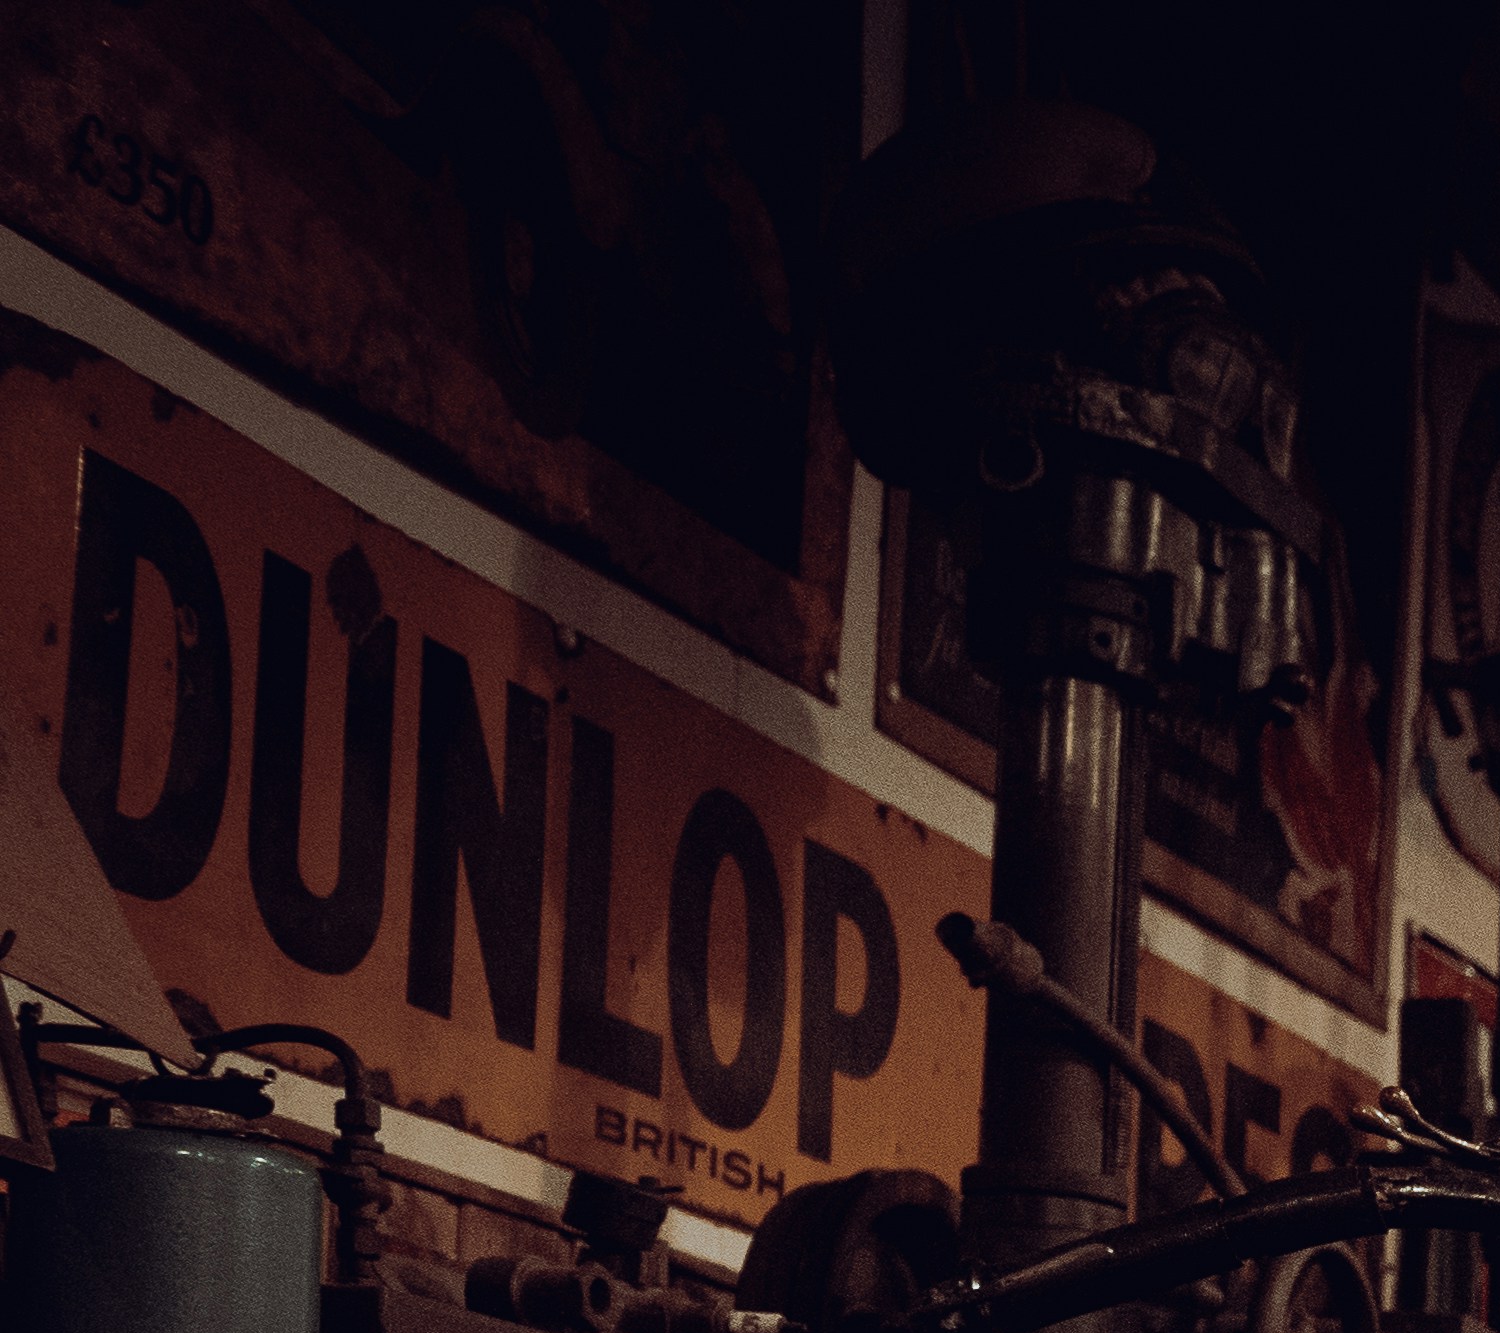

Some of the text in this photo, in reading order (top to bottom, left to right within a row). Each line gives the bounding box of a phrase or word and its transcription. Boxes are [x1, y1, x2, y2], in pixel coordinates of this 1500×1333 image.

[67, 115, 214, 248] £350
[58, 445, 900, 1164] DUNLOP
[597, 1103, 787, 1194] BRITISH
